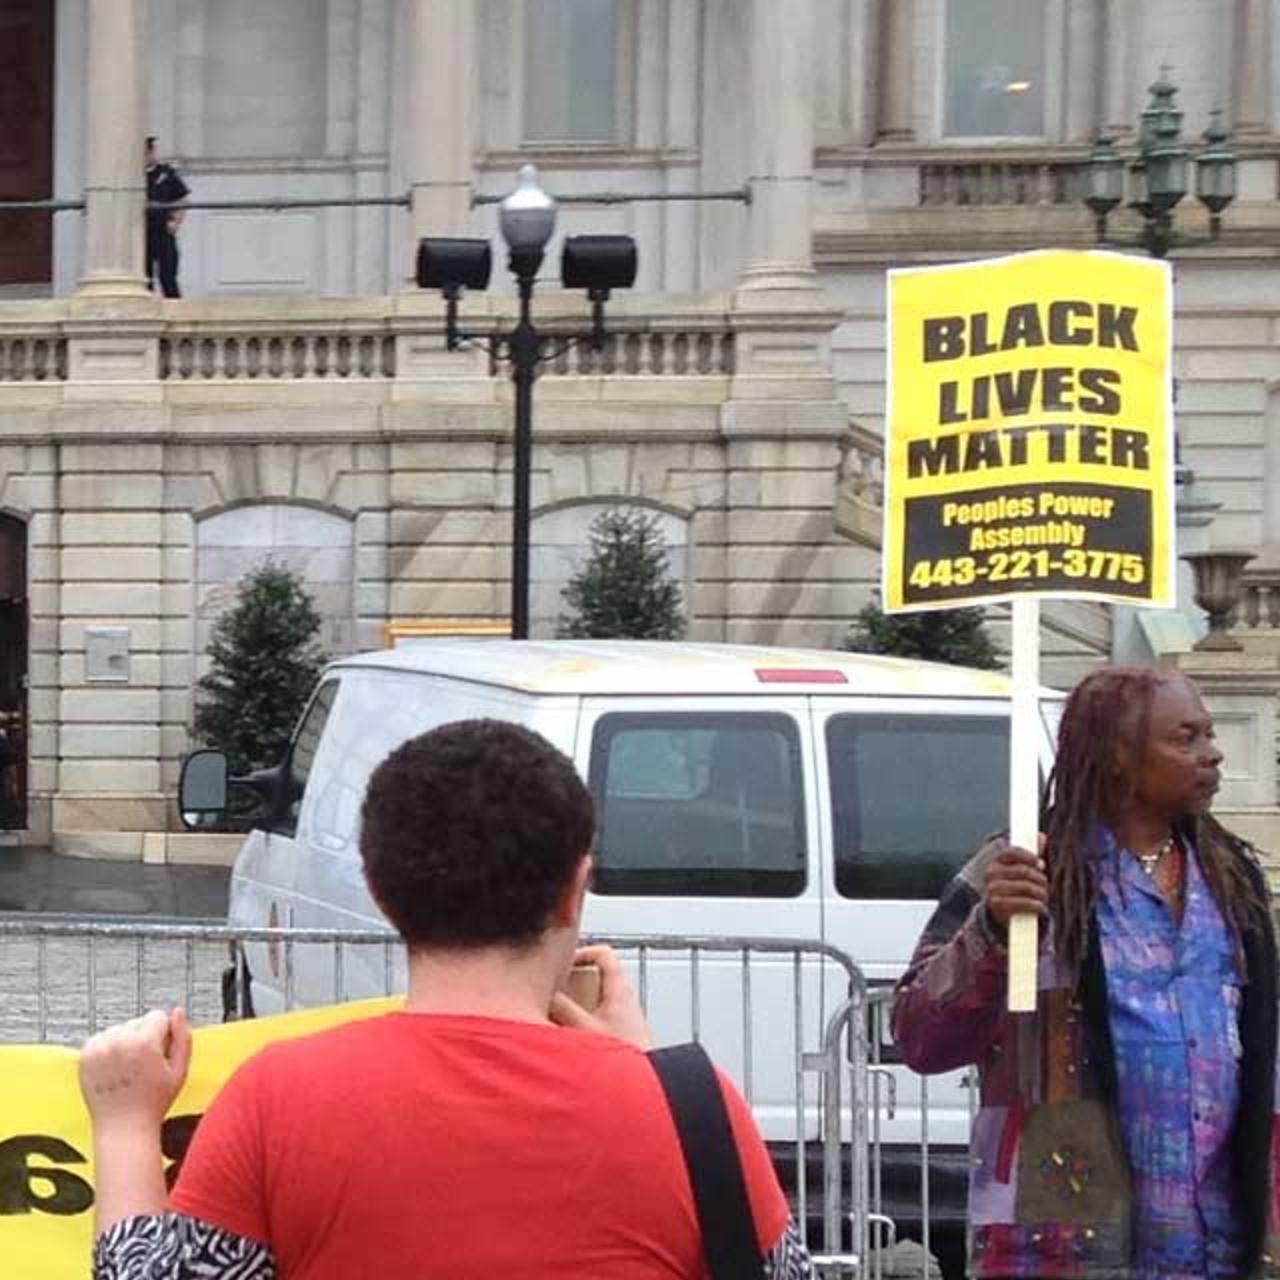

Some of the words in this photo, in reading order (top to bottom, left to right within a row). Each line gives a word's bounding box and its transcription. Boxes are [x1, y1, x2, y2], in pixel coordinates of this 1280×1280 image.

[923, 300, 1139, 363] BLACK
[940, 367, 1122, 425] LIVES
[907, 423, 1150, 479] MATTER
[943, 495, 1034, 527] Peoples
[1039, 491, 1116, 520] Power
[969, 521, 1086, 551] Assembly
[909, 549, 1145, 589] 443-221-3775
